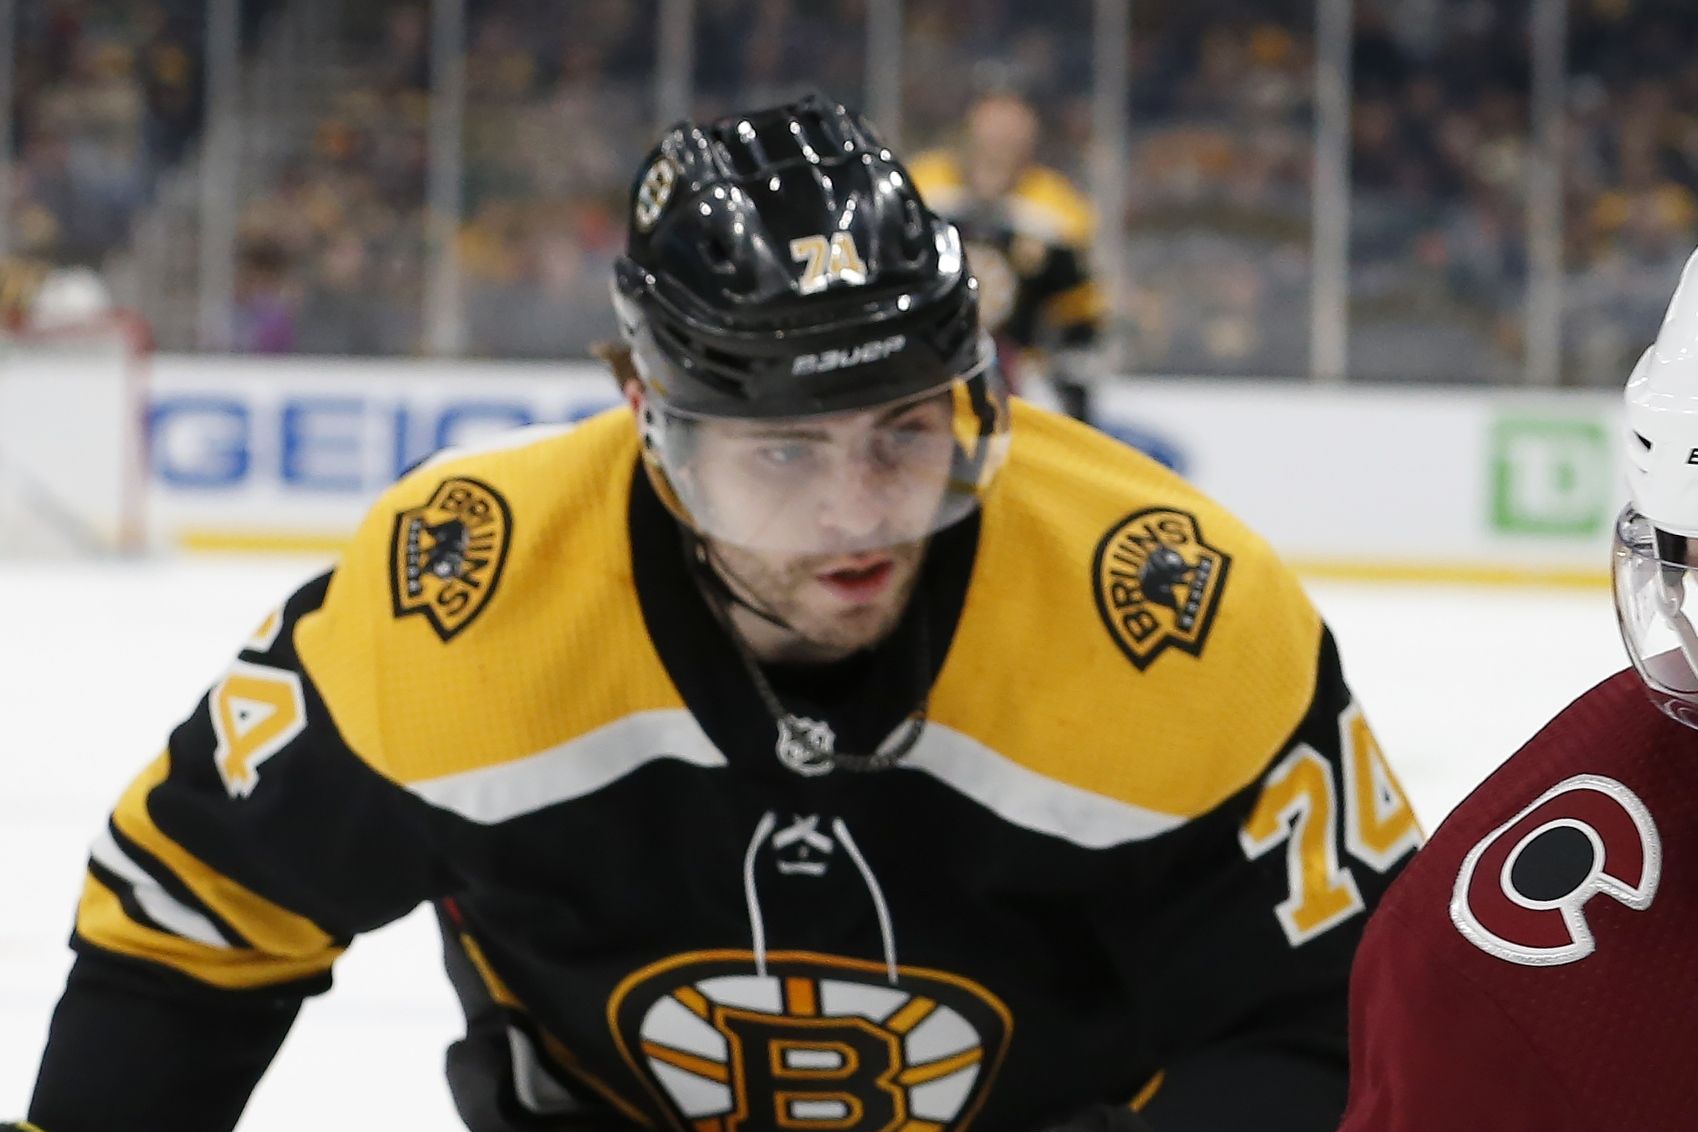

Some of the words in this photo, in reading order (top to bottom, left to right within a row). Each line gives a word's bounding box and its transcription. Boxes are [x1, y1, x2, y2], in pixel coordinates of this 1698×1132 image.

[790, 231, 867, 295] 74
[438, 487, 496, 617] BRUINS
[1110, 518, 1188, 634] BRUINS
